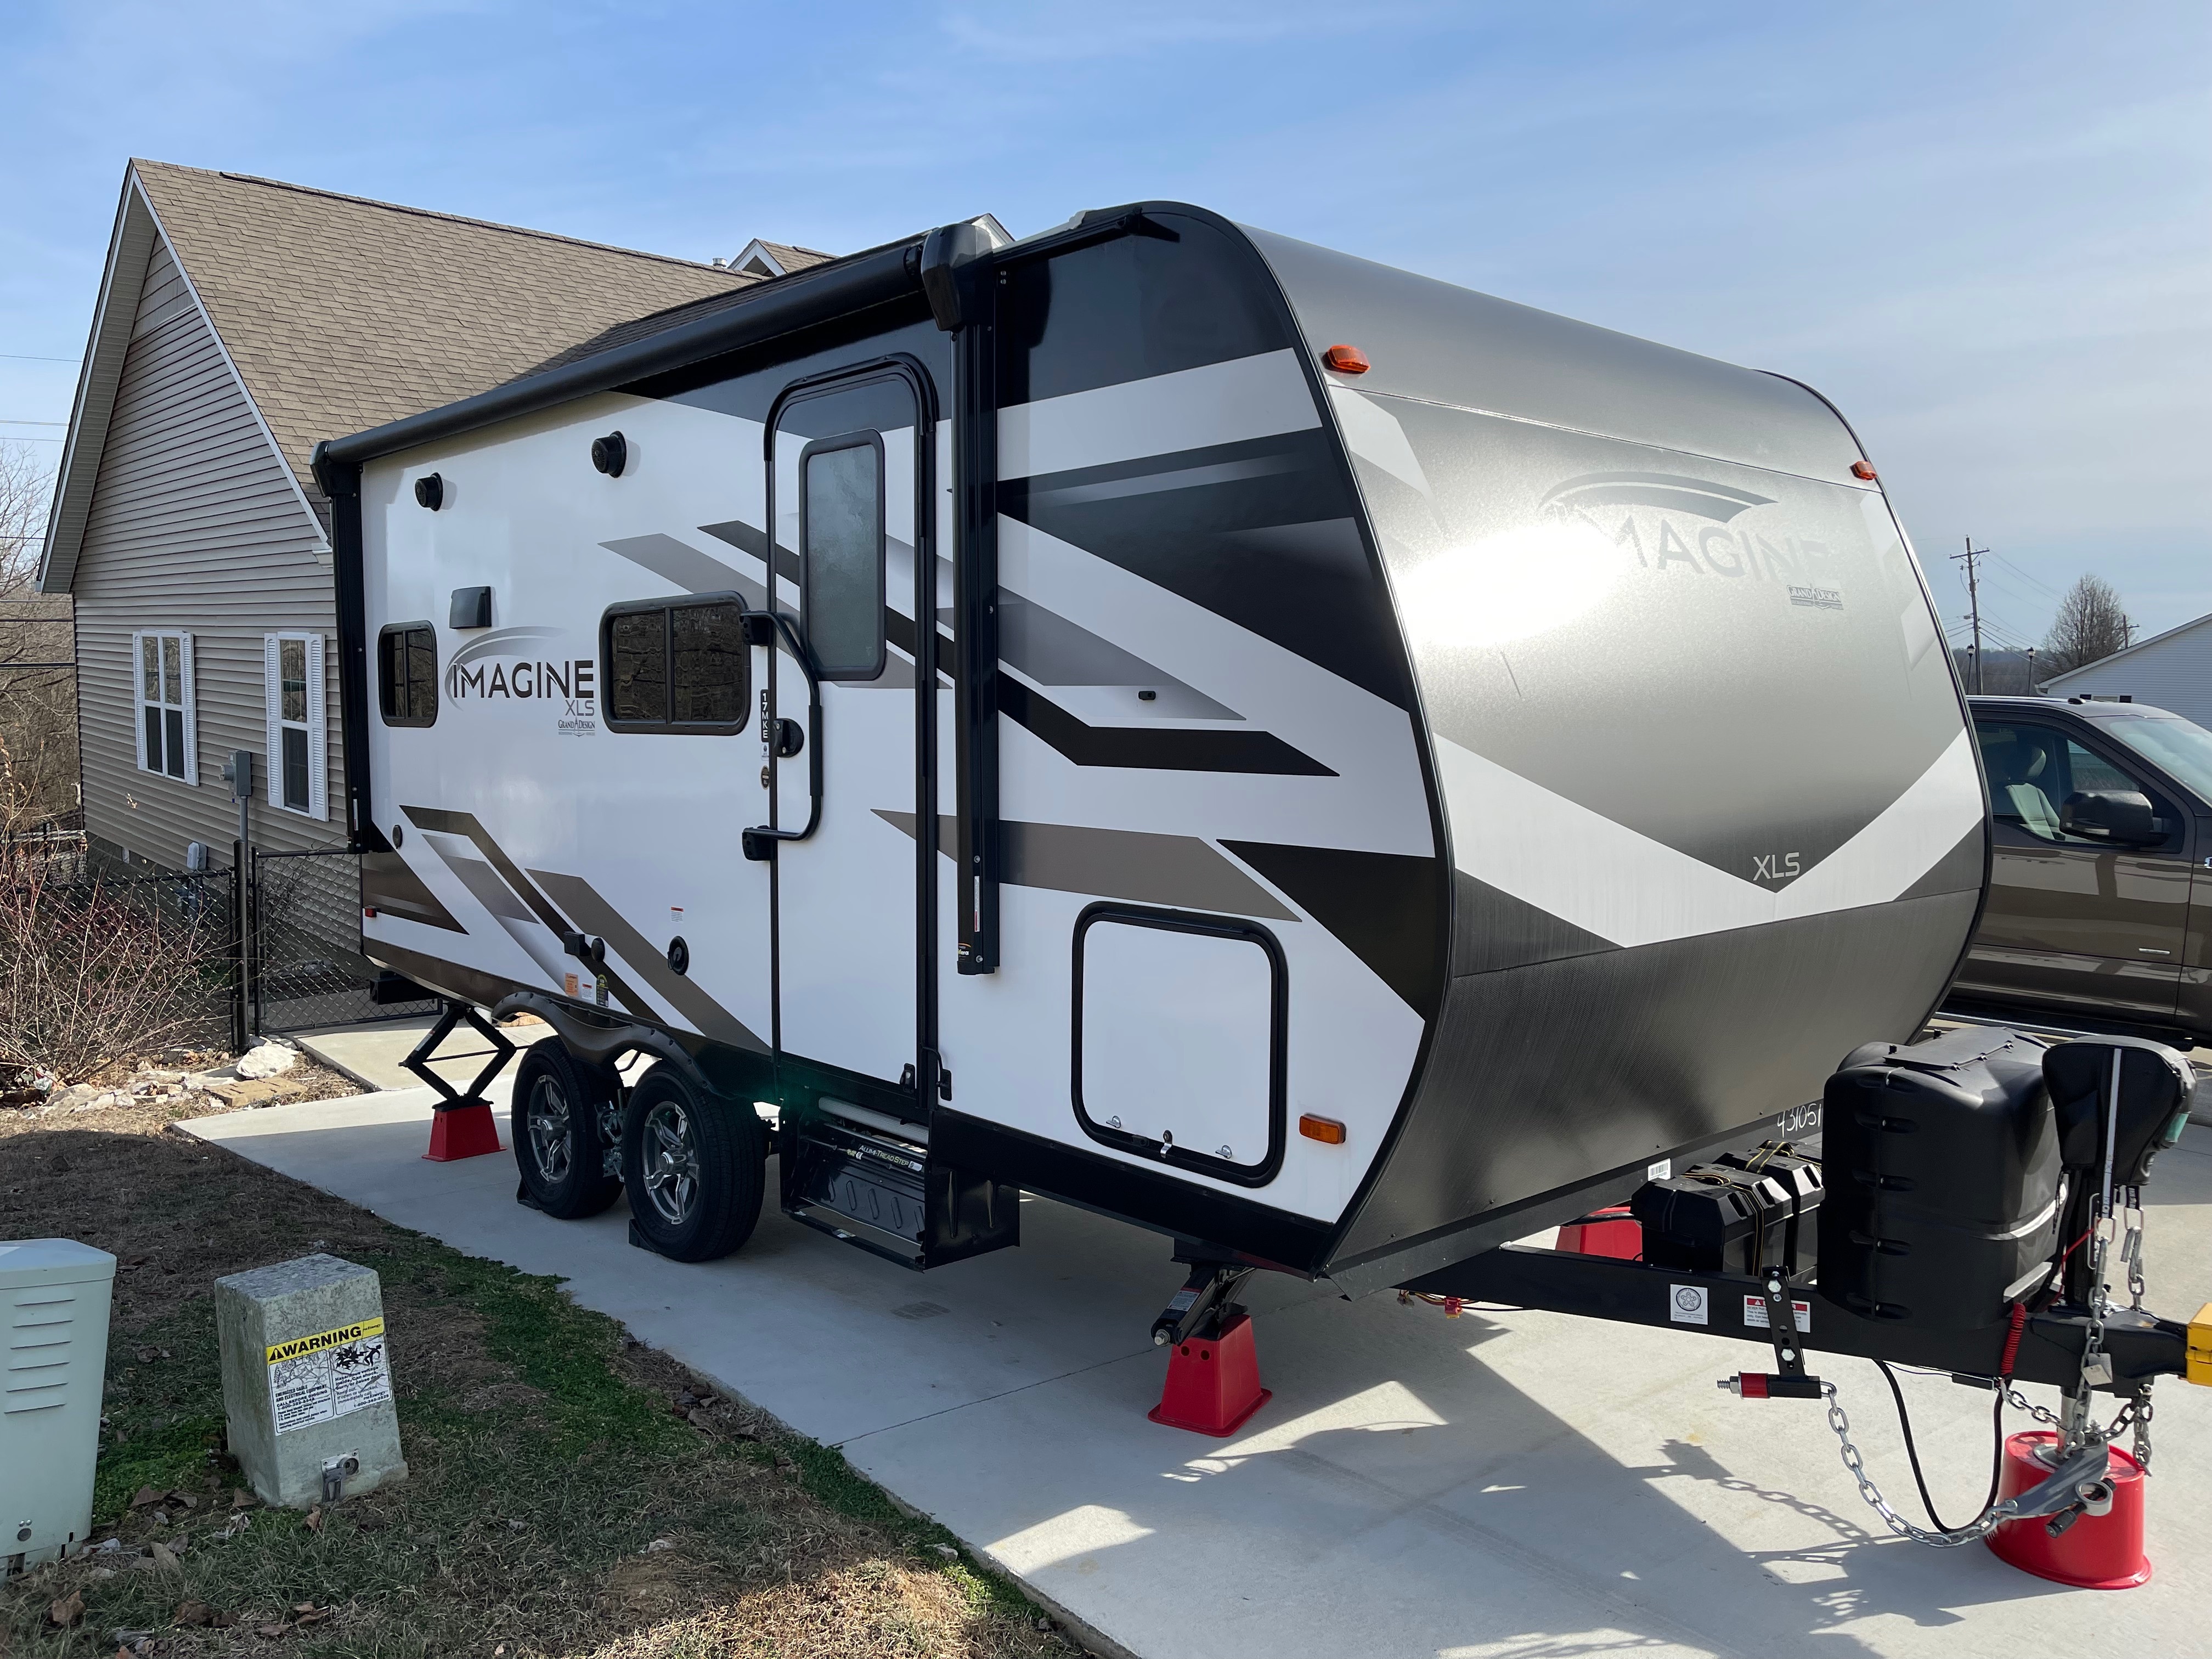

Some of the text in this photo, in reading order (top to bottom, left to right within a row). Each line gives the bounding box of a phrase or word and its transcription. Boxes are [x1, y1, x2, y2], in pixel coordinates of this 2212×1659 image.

[1544, 502, 1837, 580] MAGINE
[453, 660, 594, 698] IMAGINE
[565, 700, 595, 716] XLS
[558, 719, 595, 729] GRAND DESIGN
[1753, 852, 1801, 881] XLS
[1777, 1103, 1822, 1138] 431051
[893, 1156, 909, 1166] STEP
[282, 1326, 362, 1356] WARNING
